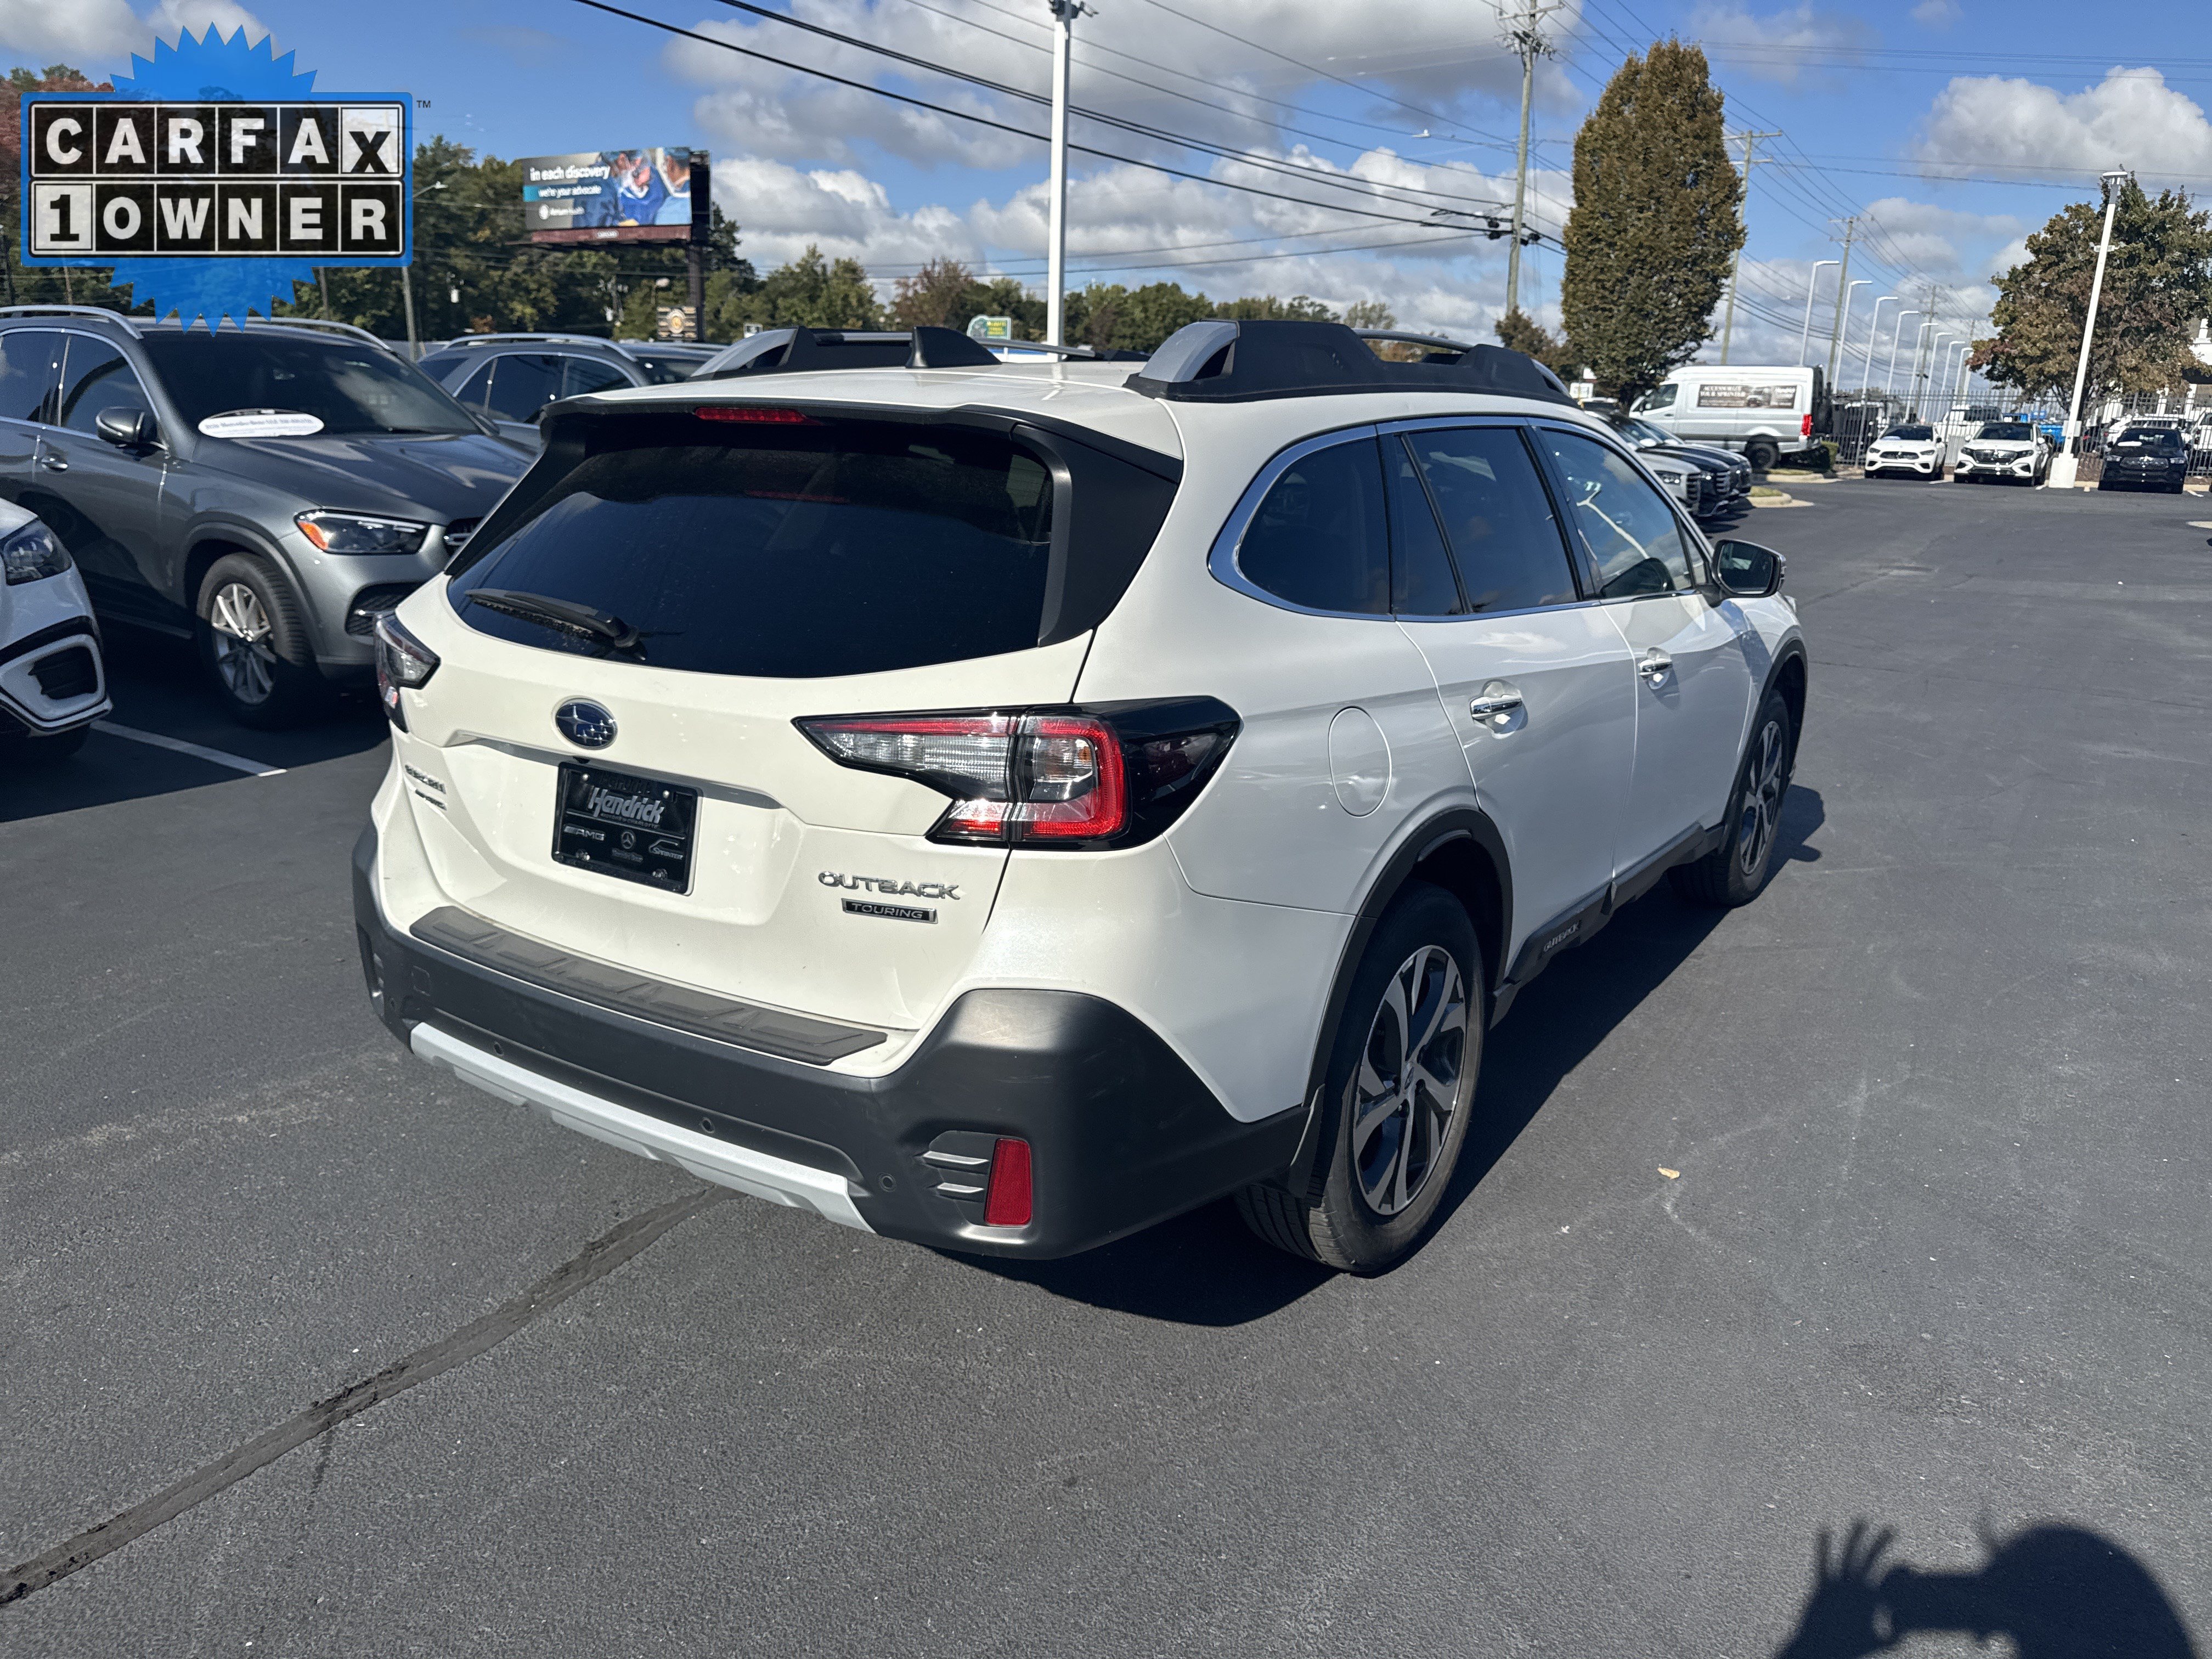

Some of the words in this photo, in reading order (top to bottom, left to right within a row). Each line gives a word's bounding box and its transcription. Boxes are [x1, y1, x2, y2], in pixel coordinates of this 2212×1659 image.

[529, 167, 541, 181] in
[541, 166, 565, 180] each
[565, 165, 610, 180] discovery
[538, 187, 556, 198] we're
[556, 188, 571, 198] your
[572, 185, 602, 195] advocate
[588, 787, 664, 825] Hendrick
[575, 828, 605, 842] AMG
[817, 870, 962, 900] OUTBACK
[851, 902, 924, 919] TOURING
